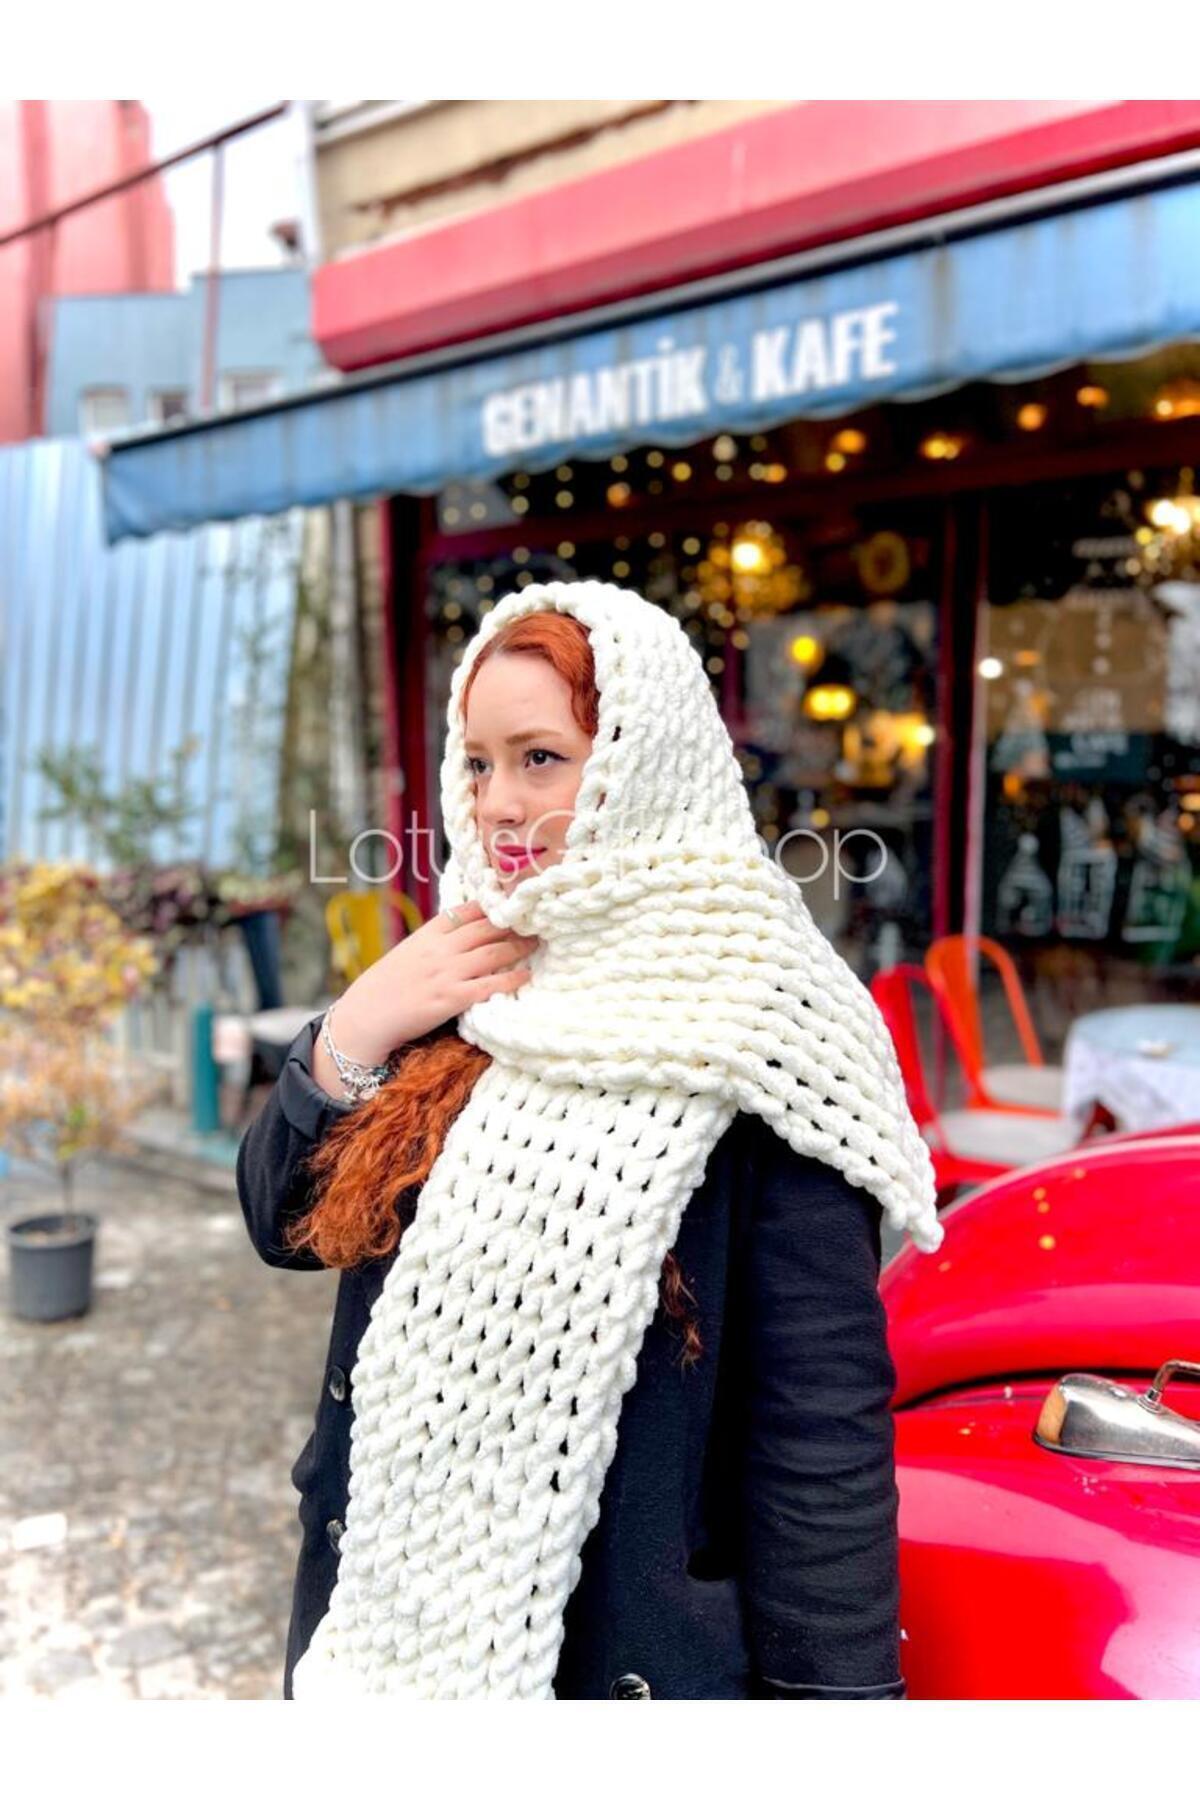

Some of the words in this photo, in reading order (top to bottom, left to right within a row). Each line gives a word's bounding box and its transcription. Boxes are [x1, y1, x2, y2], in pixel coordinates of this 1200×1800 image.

[482, 336, 709, 457] GENANTİK
[715, 342, 743, 405] &
[752, 301, 898, 402] KAFE
